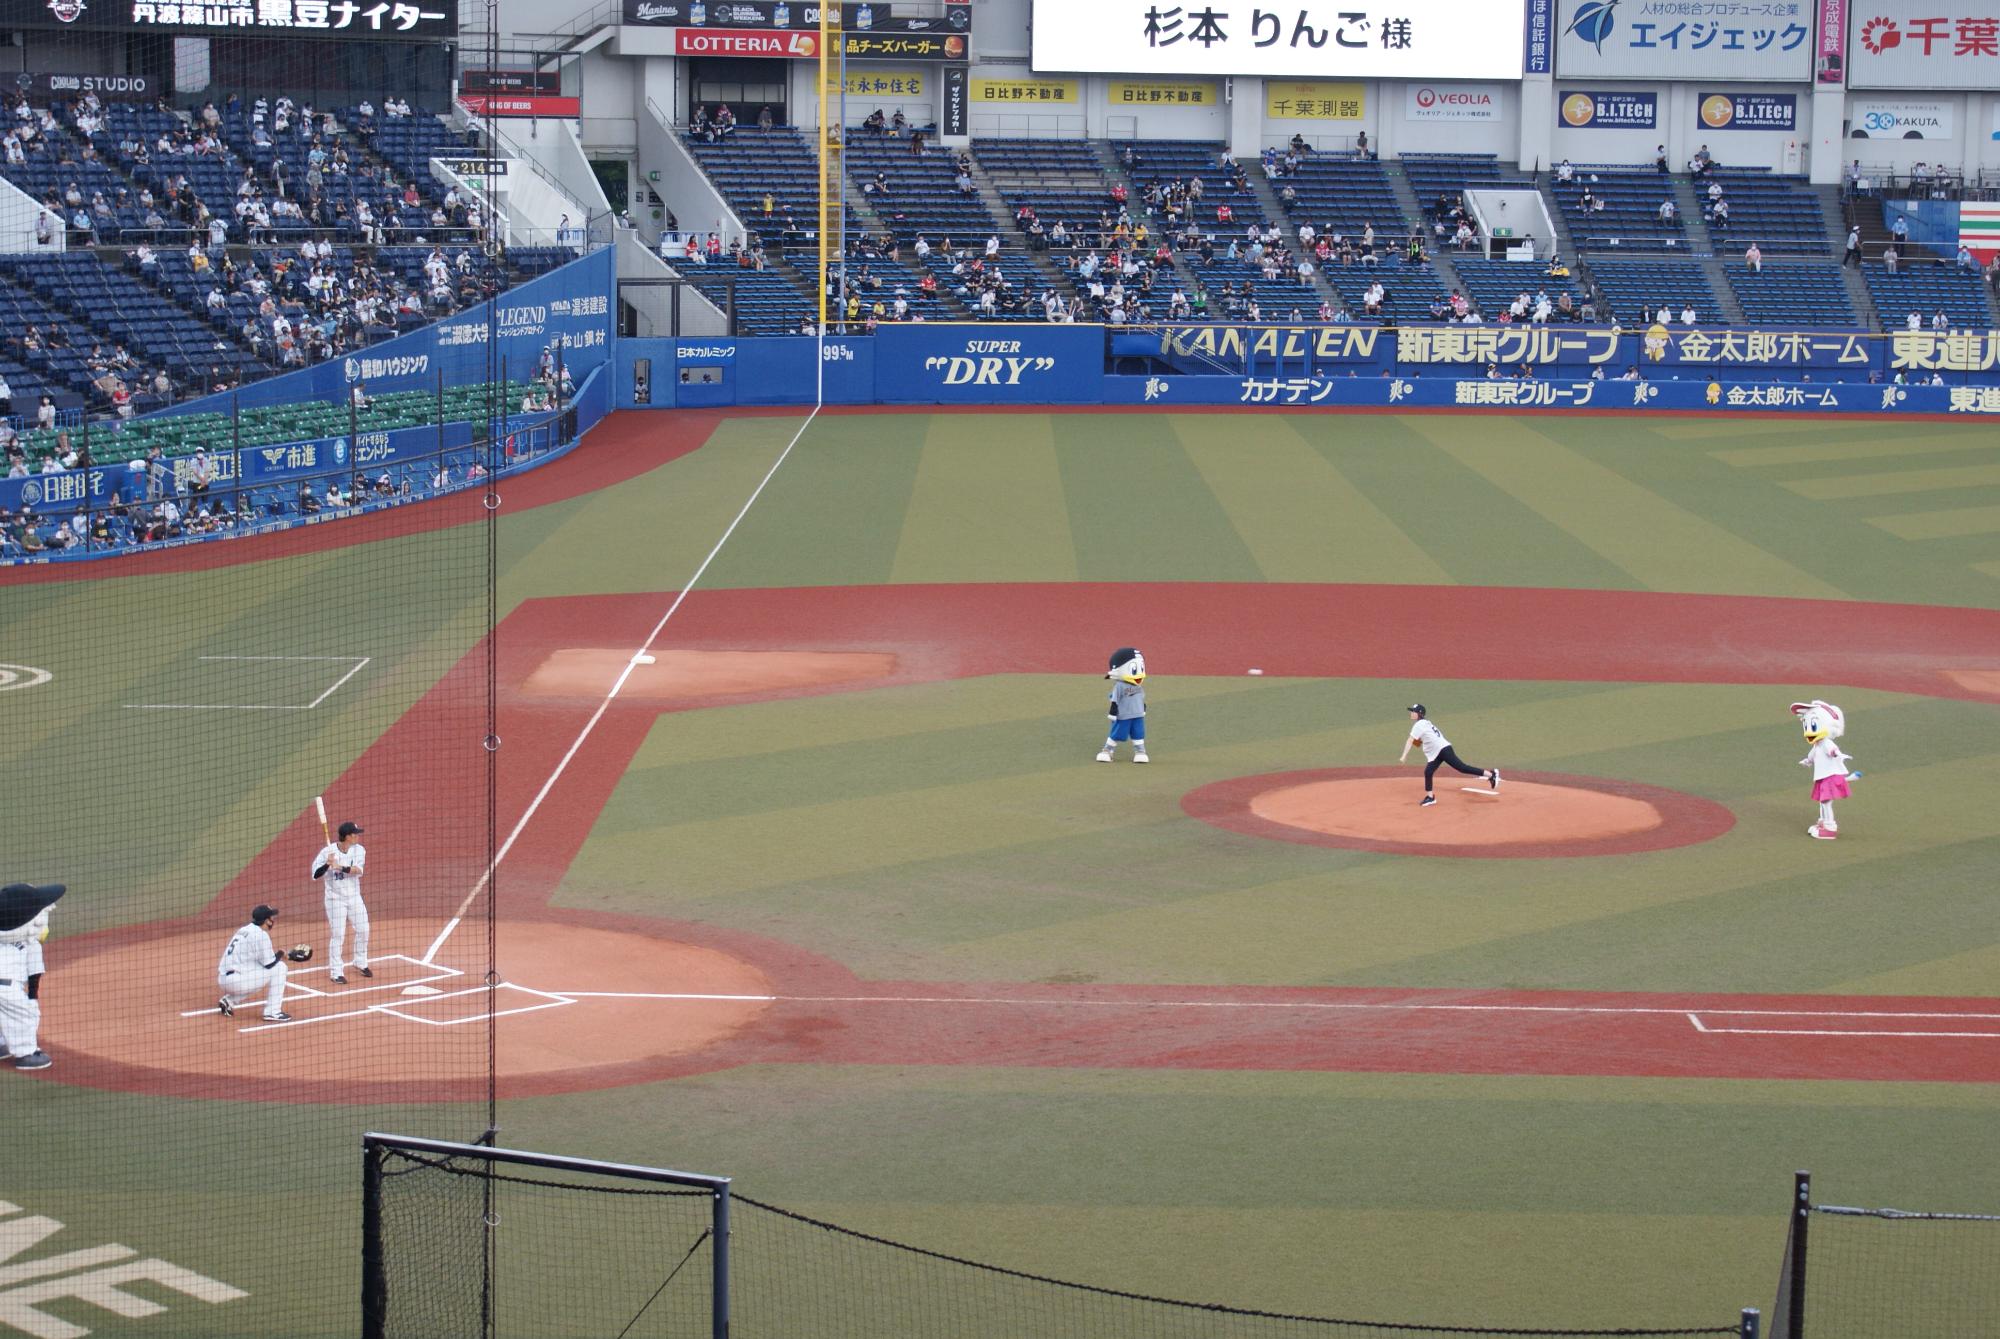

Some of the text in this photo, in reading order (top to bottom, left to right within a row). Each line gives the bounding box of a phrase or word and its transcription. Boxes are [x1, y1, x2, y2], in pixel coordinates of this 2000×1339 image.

[1640, 2, 1799, 17] 人材の総合プロデュース企業
[1144, 6, 1412, 49] 杉本 りんご 様
[683, 36, 783, 52] LOTTERIA
[1629, 22, 1808, 51] エイジェック
[1906, 17, 2000, 56] 千葉
[83, 77, 146, 92] STUDIO
[857, 77, 920, 94] 永和住宅
[985, 87, 1065, 100] 日比野不動産
[1123, 90, 1203, 103] 日比野不動産
[1438, 94, 1491, 105] VEOLIA
[512, 102, 532, 110] BEERS
[1273, 99, 1359, 117] 千葉測器
[1596, 103, 1653, 118] B.I.TECH
[1735, 105, 1792, 119] B.I.TECH
[1895, 118, 1939, 128] KAKUTA
[461, 162, 485, 175] 214
[500, 305, 546, 326] LEGEND
[966, 340, 1021, 353] SUPER
[1397, 325, 1621, 363] 新東京グループ
[1679, 329, 1869, 363] 金太郎ホーム
[677, 347, 736, 358] 日本カルミック
[1241, 378, 1334, 402] カナデン
[1455, 380, 1594, 405] 新東京グループ
[1727, 386, 1839, 406] 金太郎ホーム
[287, 444, 316, 469] 市進
[227, 938, 239, 956] 5
